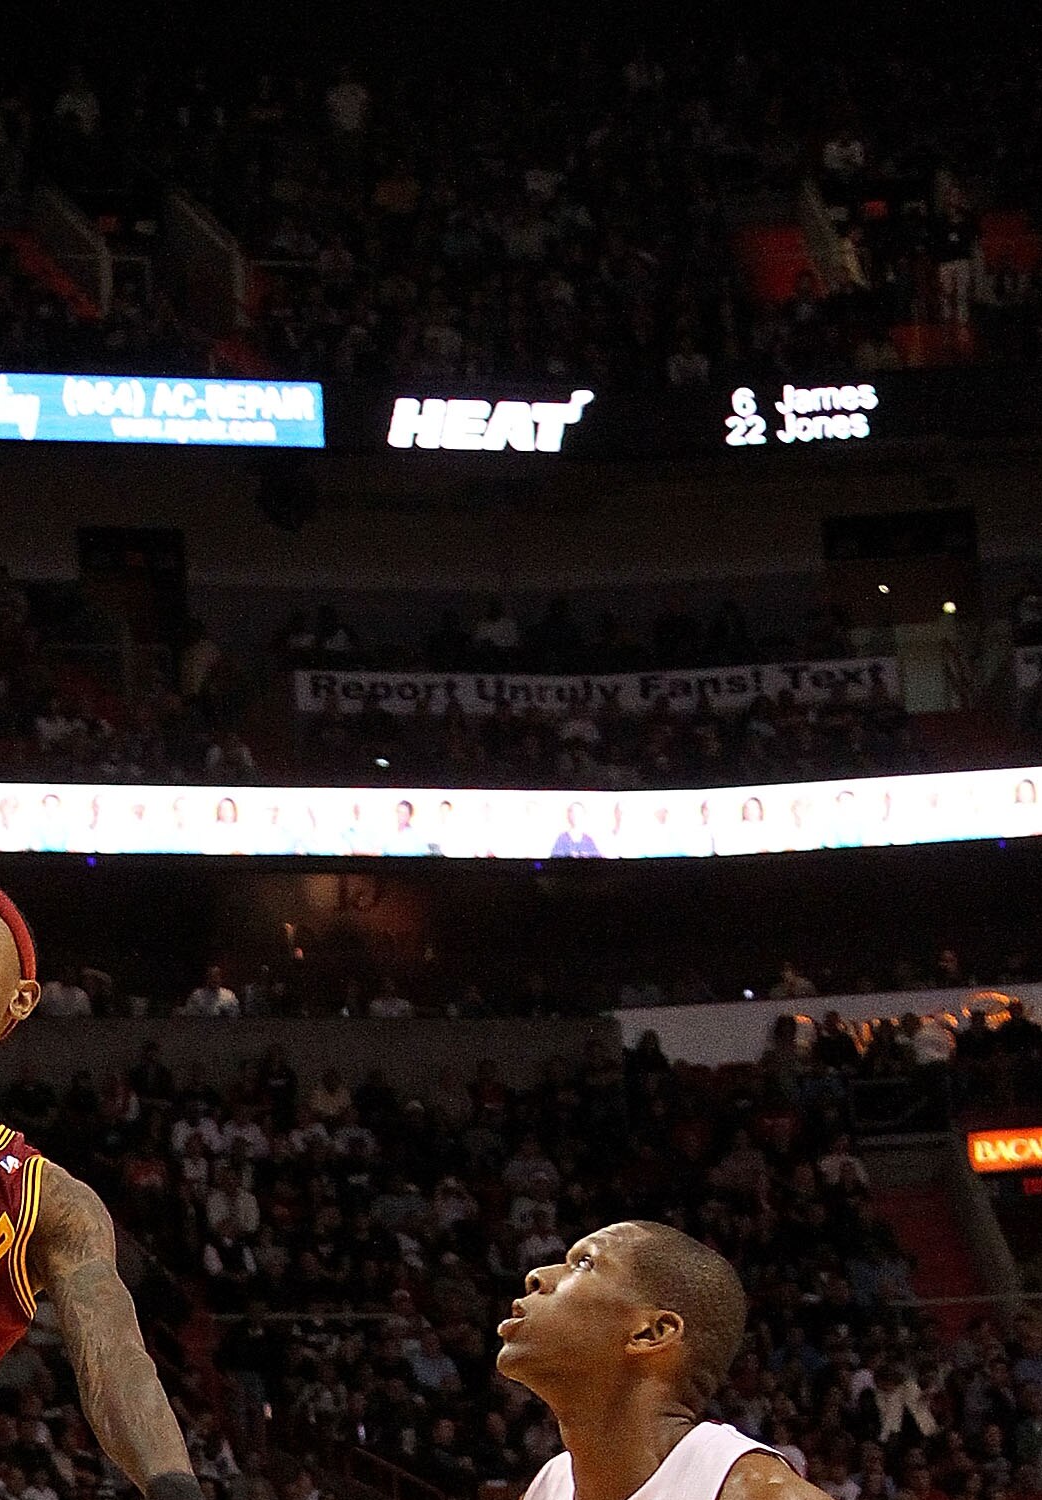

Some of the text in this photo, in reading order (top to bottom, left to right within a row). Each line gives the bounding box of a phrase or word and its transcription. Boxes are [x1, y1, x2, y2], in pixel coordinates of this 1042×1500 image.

[731, 384, 878, 417] 6 James
[388, 390, 594, 451] HEAT
[725, 413, 870, 446] 22 Jones
[309, 662, 885, 704] Report Unruly Fans! Text
